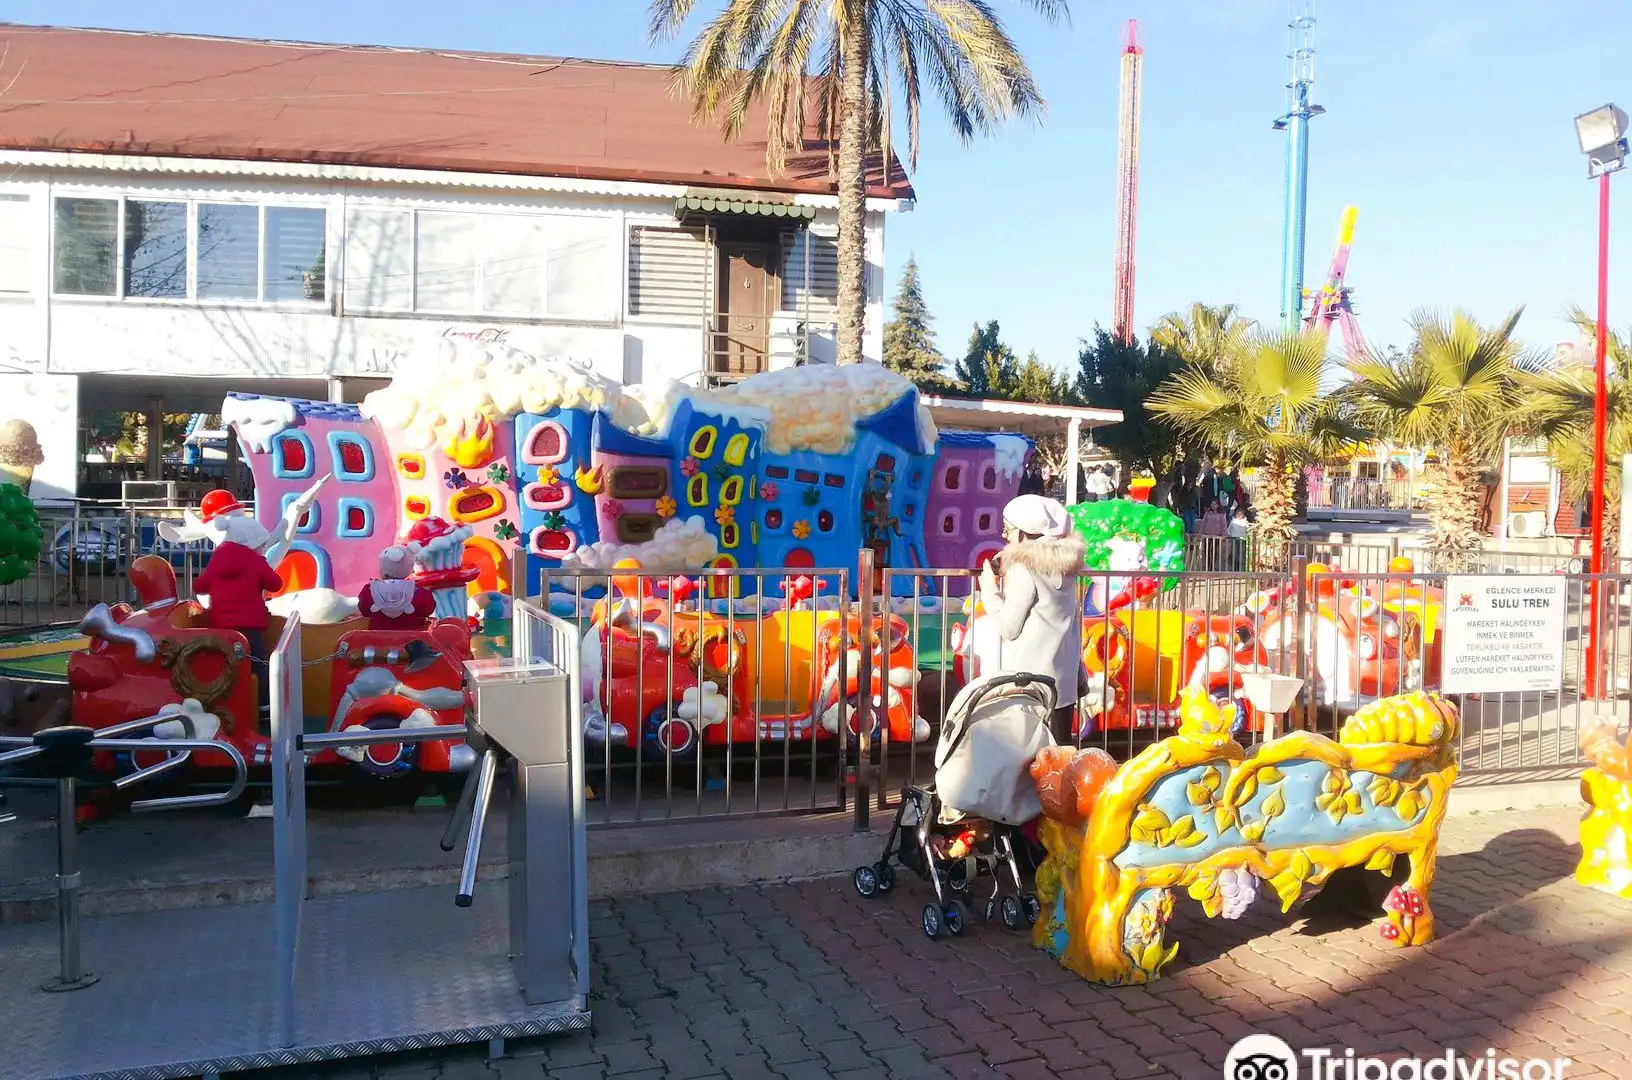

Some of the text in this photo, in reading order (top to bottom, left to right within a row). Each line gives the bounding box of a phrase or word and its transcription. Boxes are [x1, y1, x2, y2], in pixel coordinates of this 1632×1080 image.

[1491, 598, 1550, 608] SULU TREN
[1467, 620, 1499, 628] HAREKET
[1499, 631, 1508, 639] VE
[1481, 654, 1511, 663] HAREKET
